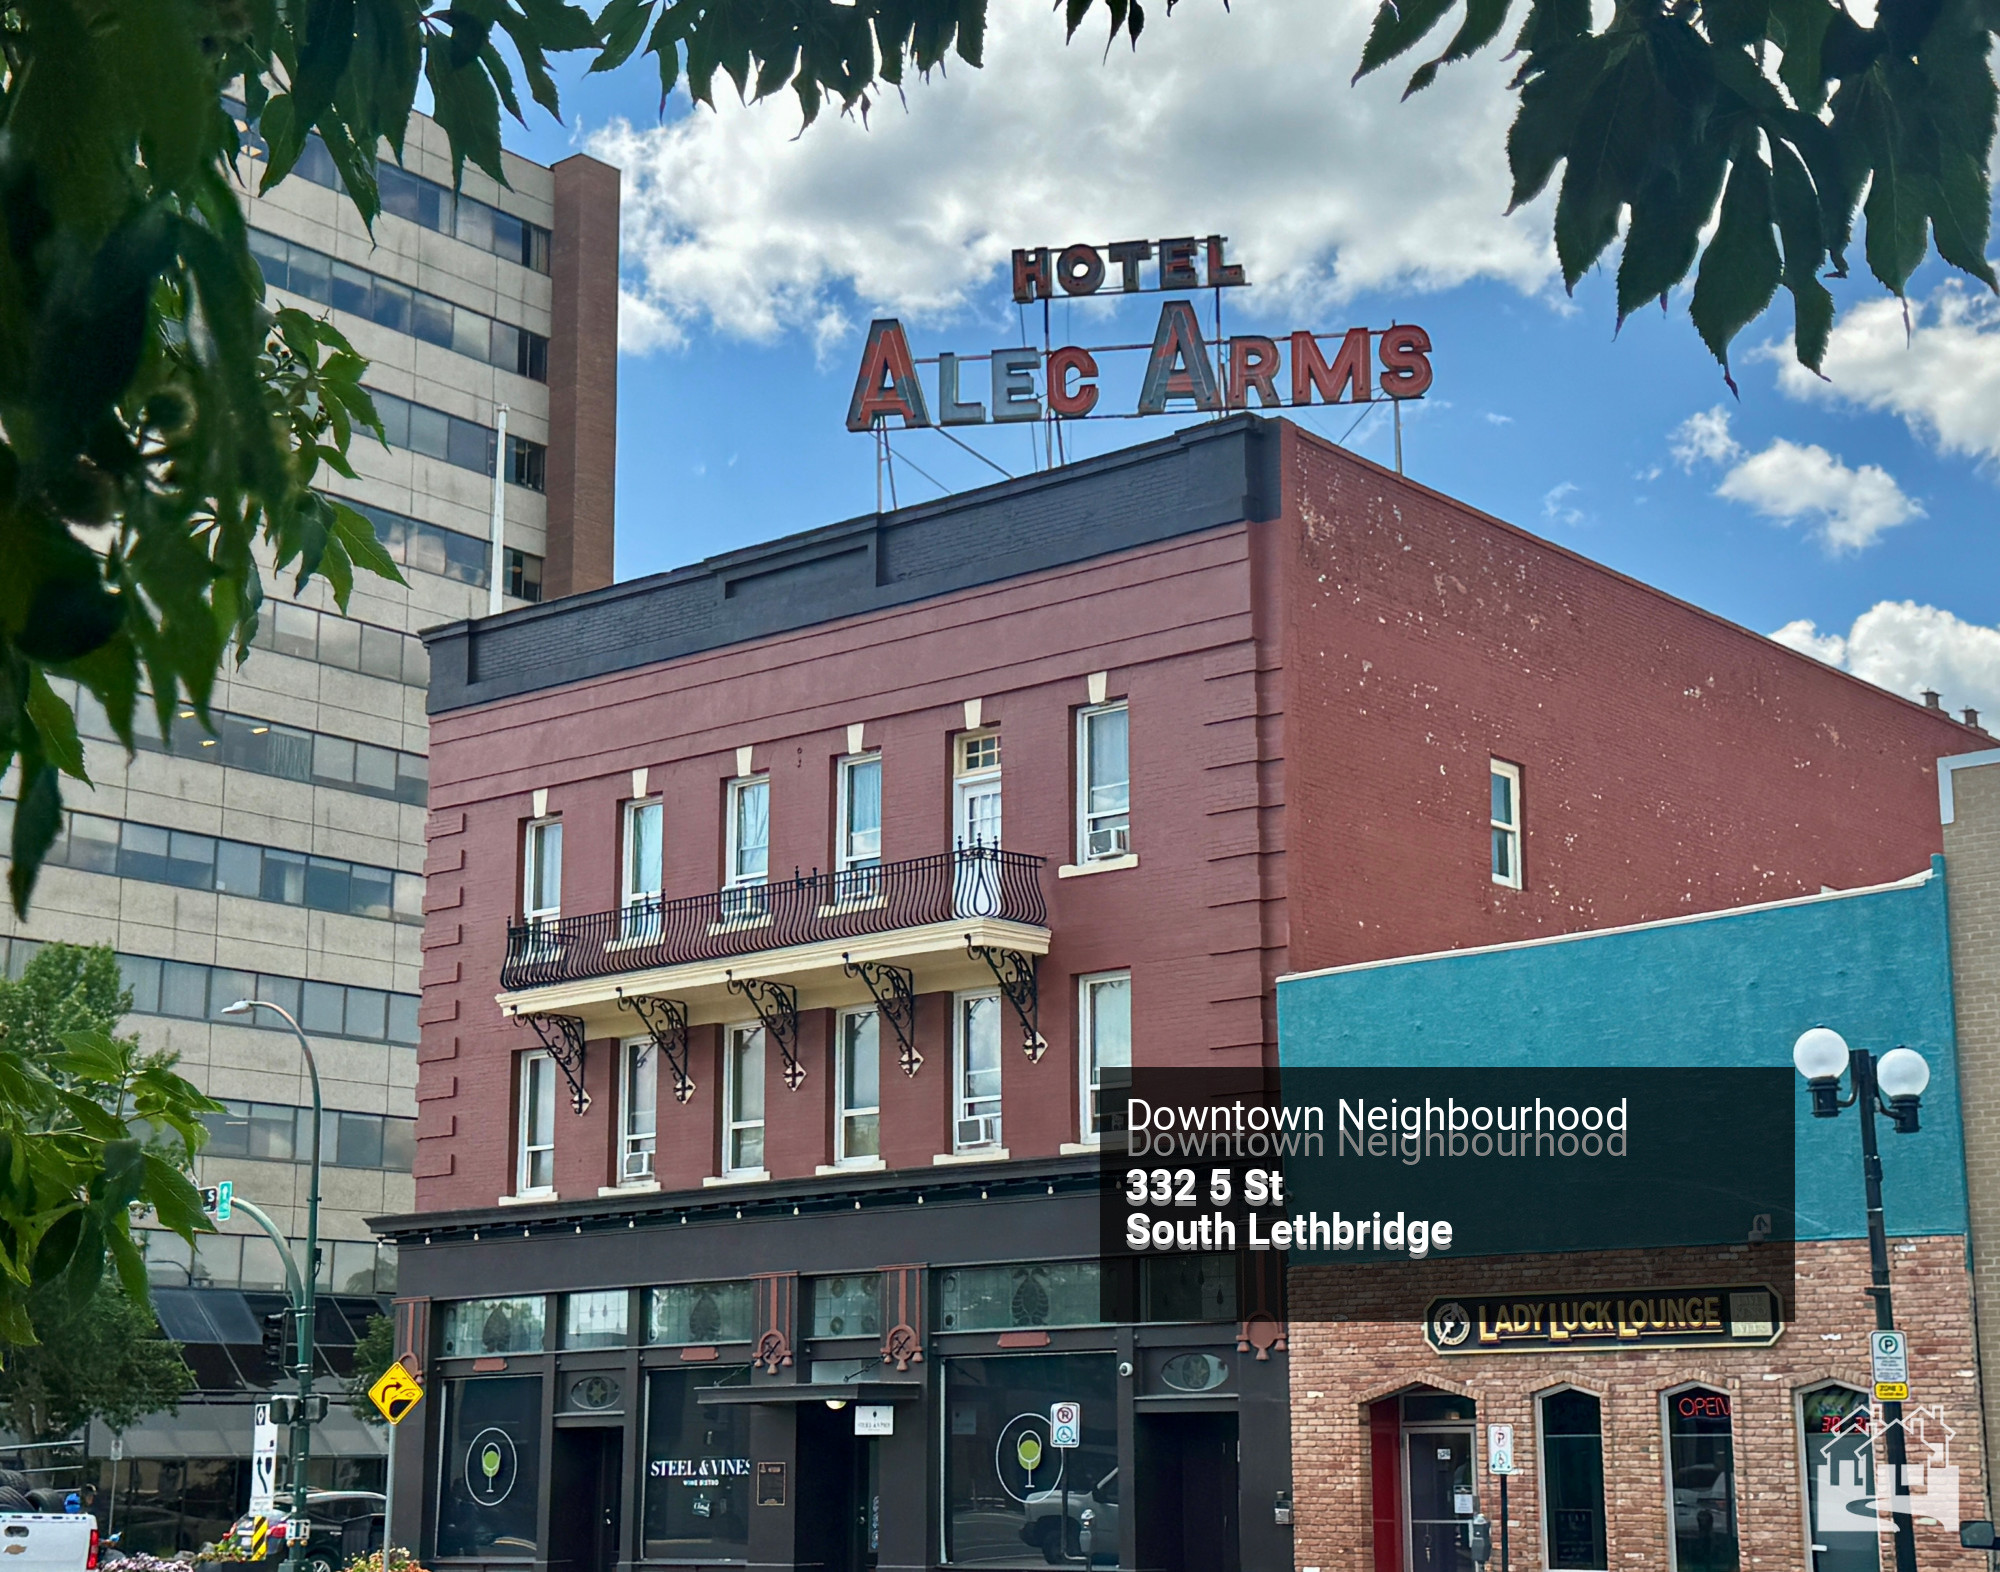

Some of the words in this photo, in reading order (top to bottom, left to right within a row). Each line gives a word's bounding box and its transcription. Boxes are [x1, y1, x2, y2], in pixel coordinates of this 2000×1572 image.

[1012, 235, 1246, 303] HOTEL
[846, 318, 1099, 432] ALEC
[1138, 300, 1433, 416] ARMS
[1478, 1302, 1545, 1341] LADY
[1550, 1300, 1614, 1339] LUCK
[1617, 1296, 1722, 1337] LOUNGE
[1678, 1397, 1732, 1416] OPEN
[650, 1459, 697, 1477] STEEL
[698, 1459, 709, 1476] &
[711, 1458, 751, 1476] VINES
